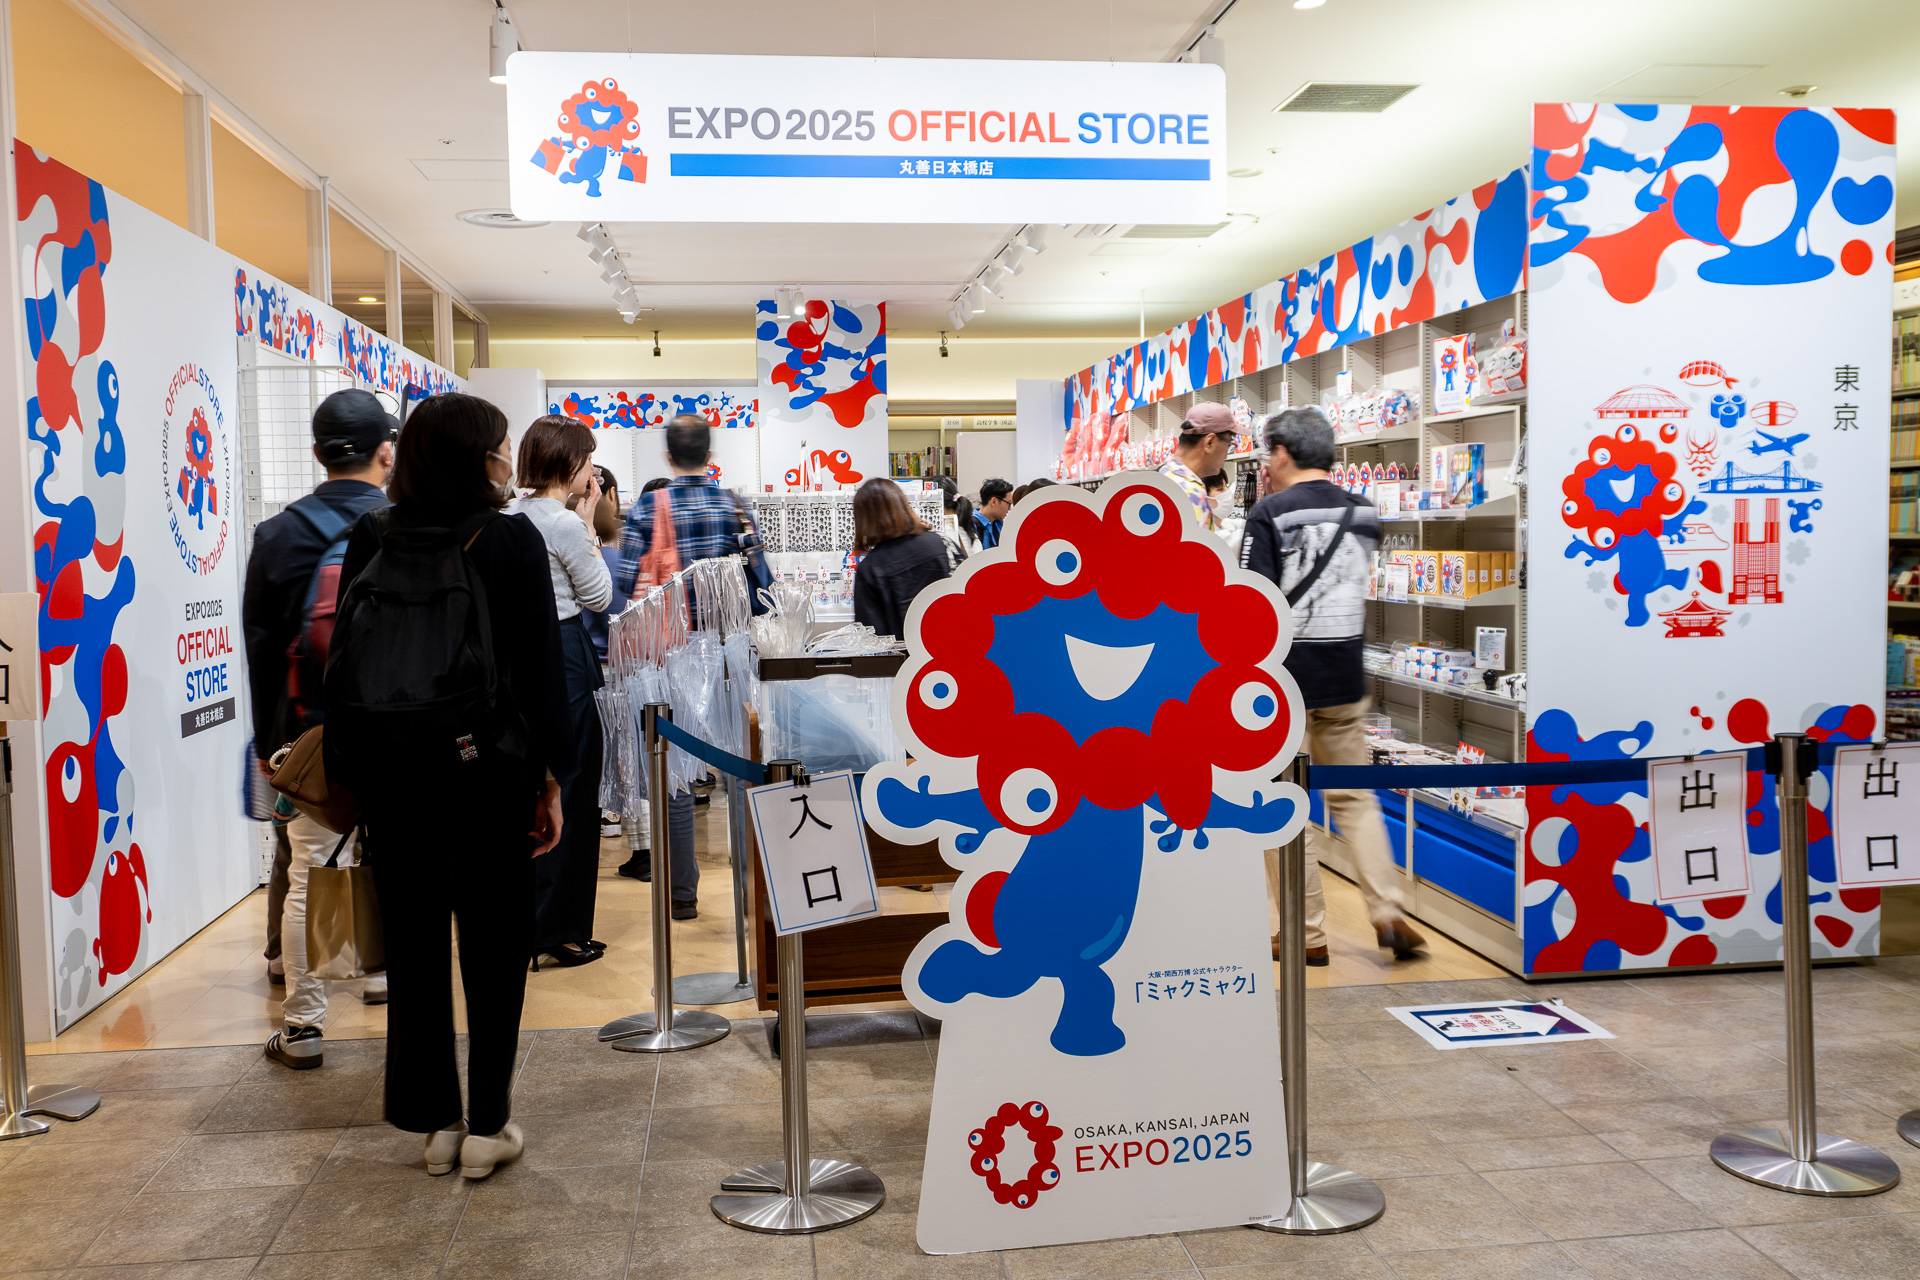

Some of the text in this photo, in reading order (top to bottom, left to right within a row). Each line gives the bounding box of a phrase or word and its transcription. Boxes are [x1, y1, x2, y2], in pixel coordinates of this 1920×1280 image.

[667, 106, 1210, 145] EXPO2025 OFFICIAL STORE
[899, 159, 994, 176] 丸善日本橋店
[165, 362, 199, 417] OFFICIAL
[198, 367, 225, 430] STORE
[1833, 364, 1861, 432] 東京
[185, 599, 223, 621] EXPO2025
[177, 625, 233, 665] OFFICIAL
[186, 662, 228, 703] STORE
[195, 706, 224, 728] 丸善日本橋店
[1680, 769, 1719, 885] 出口
[1863, 757, 1900, 871] 出口
[788, 793, 843, 909] 入口
[1135, 972, 1256, 1004] 「ミャクミャク」
[1148, 964, 1243, 979] 大阪・関西万博 公式キャラクター
[1074, 1111, 1250, 1139] OSAKA, KANSAI, JAPAN
[1075, 1130, 1252, 1173] EXPO2025
